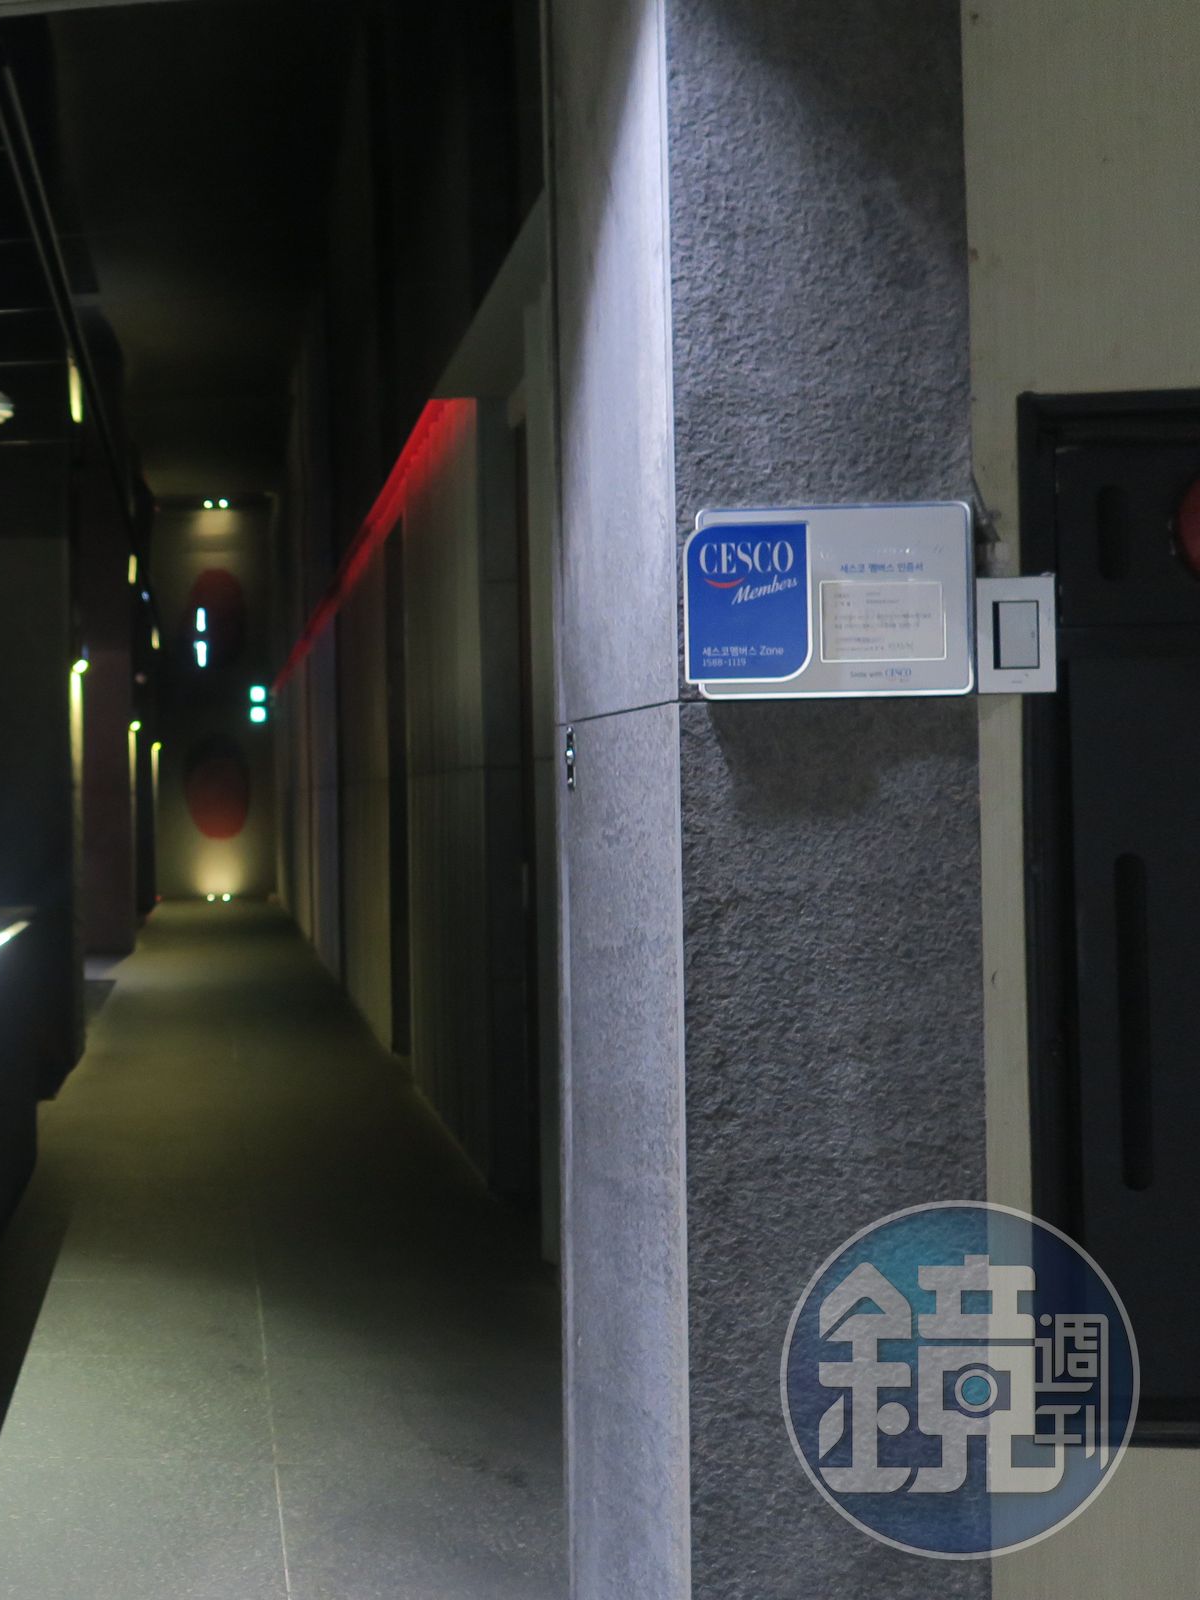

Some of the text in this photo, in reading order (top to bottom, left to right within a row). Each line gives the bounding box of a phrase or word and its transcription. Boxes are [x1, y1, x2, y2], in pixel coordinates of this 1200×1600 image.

[700, 540, 794, 574] CESCO
[731, 574, 798, 605] Members
[759, 645, 784, 656] Zone
